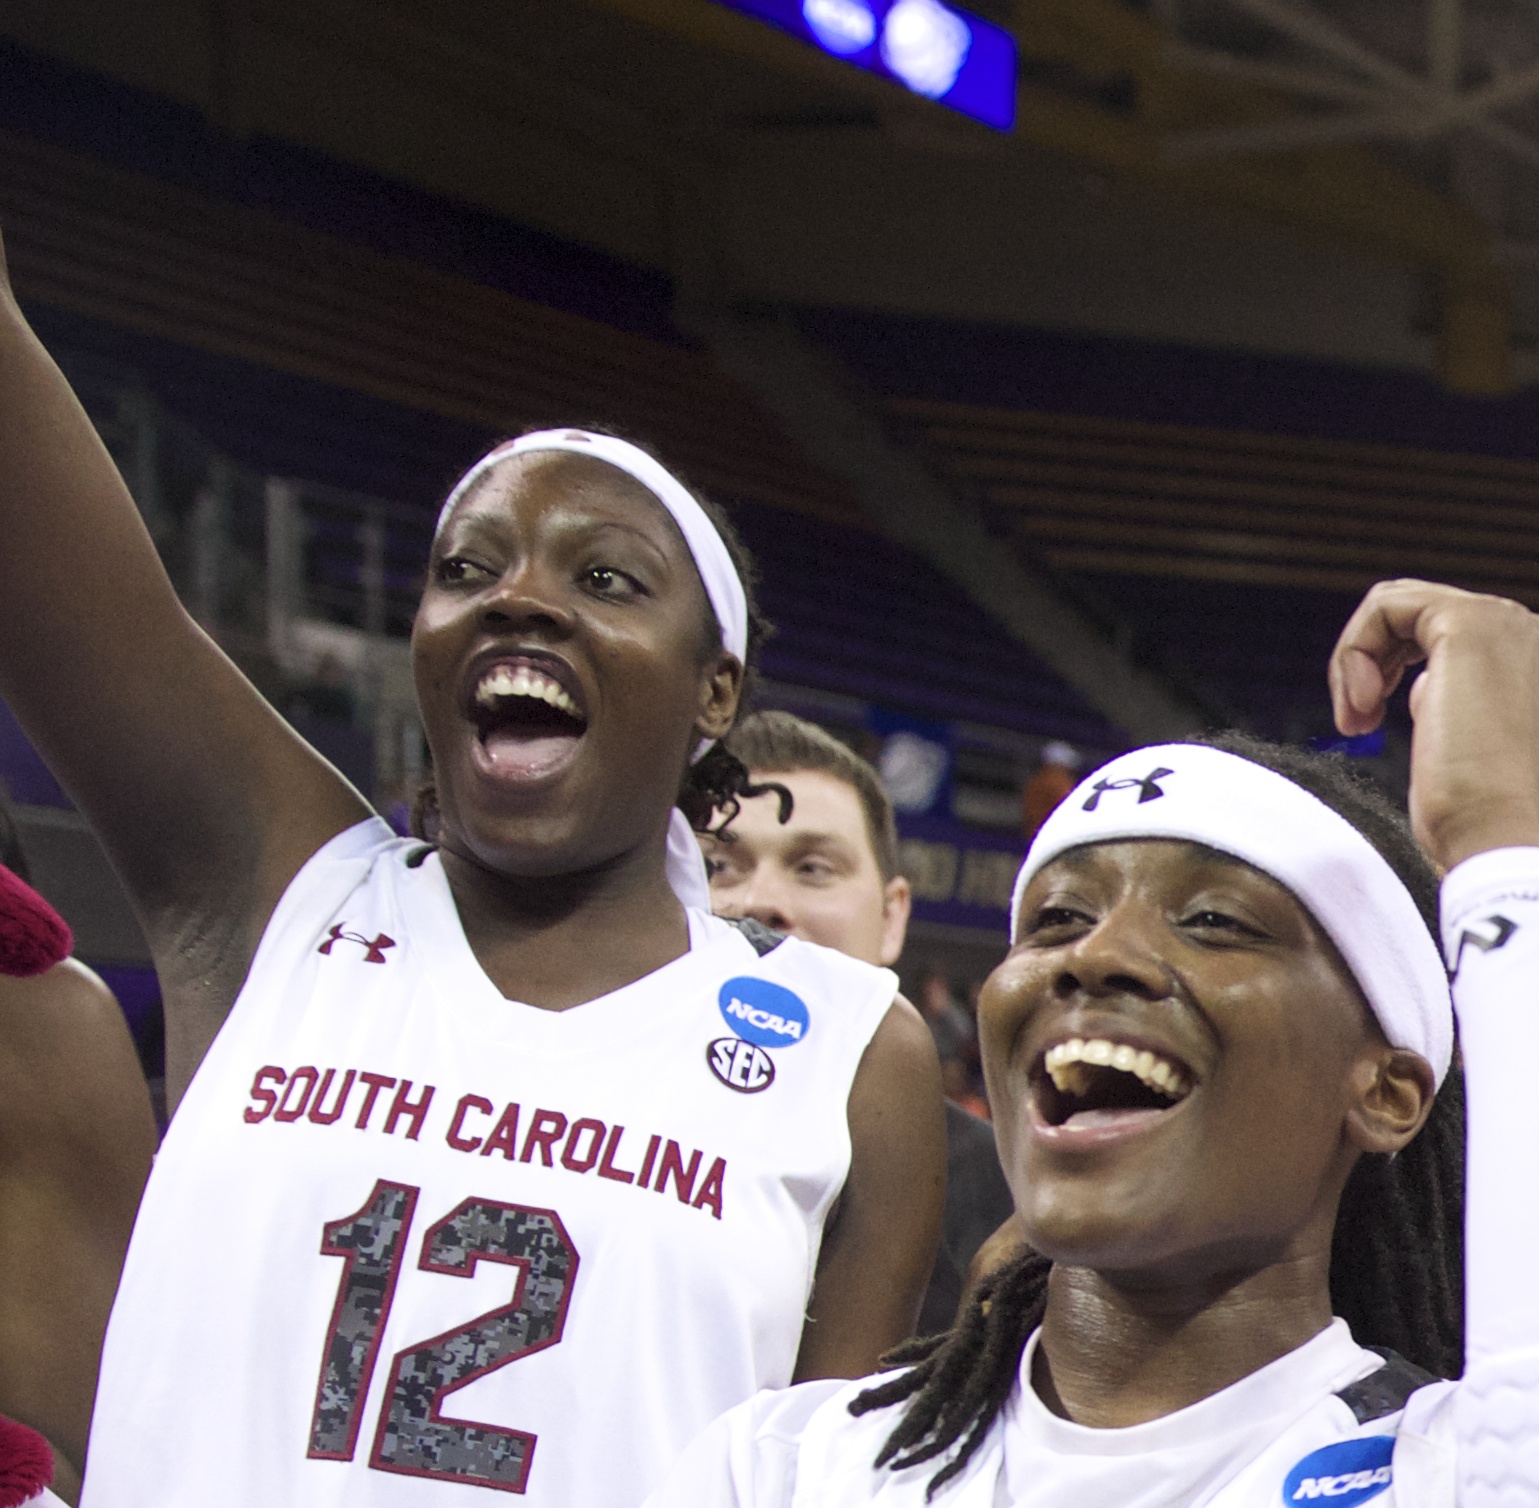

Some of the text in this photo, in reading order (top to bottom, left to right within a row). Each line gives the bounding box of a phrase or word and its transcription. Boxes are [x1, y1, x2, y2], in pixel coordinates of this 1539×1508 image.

[726, 997, 802, 1039] NCAA
[711, 1039, 772, 1089] SEC
[244, 1066, 726, 1220] SOUTH CAROLINA
[306, 1178, 580, 1494] 12
[1292, 1465, 1393, 1500] NCAA
